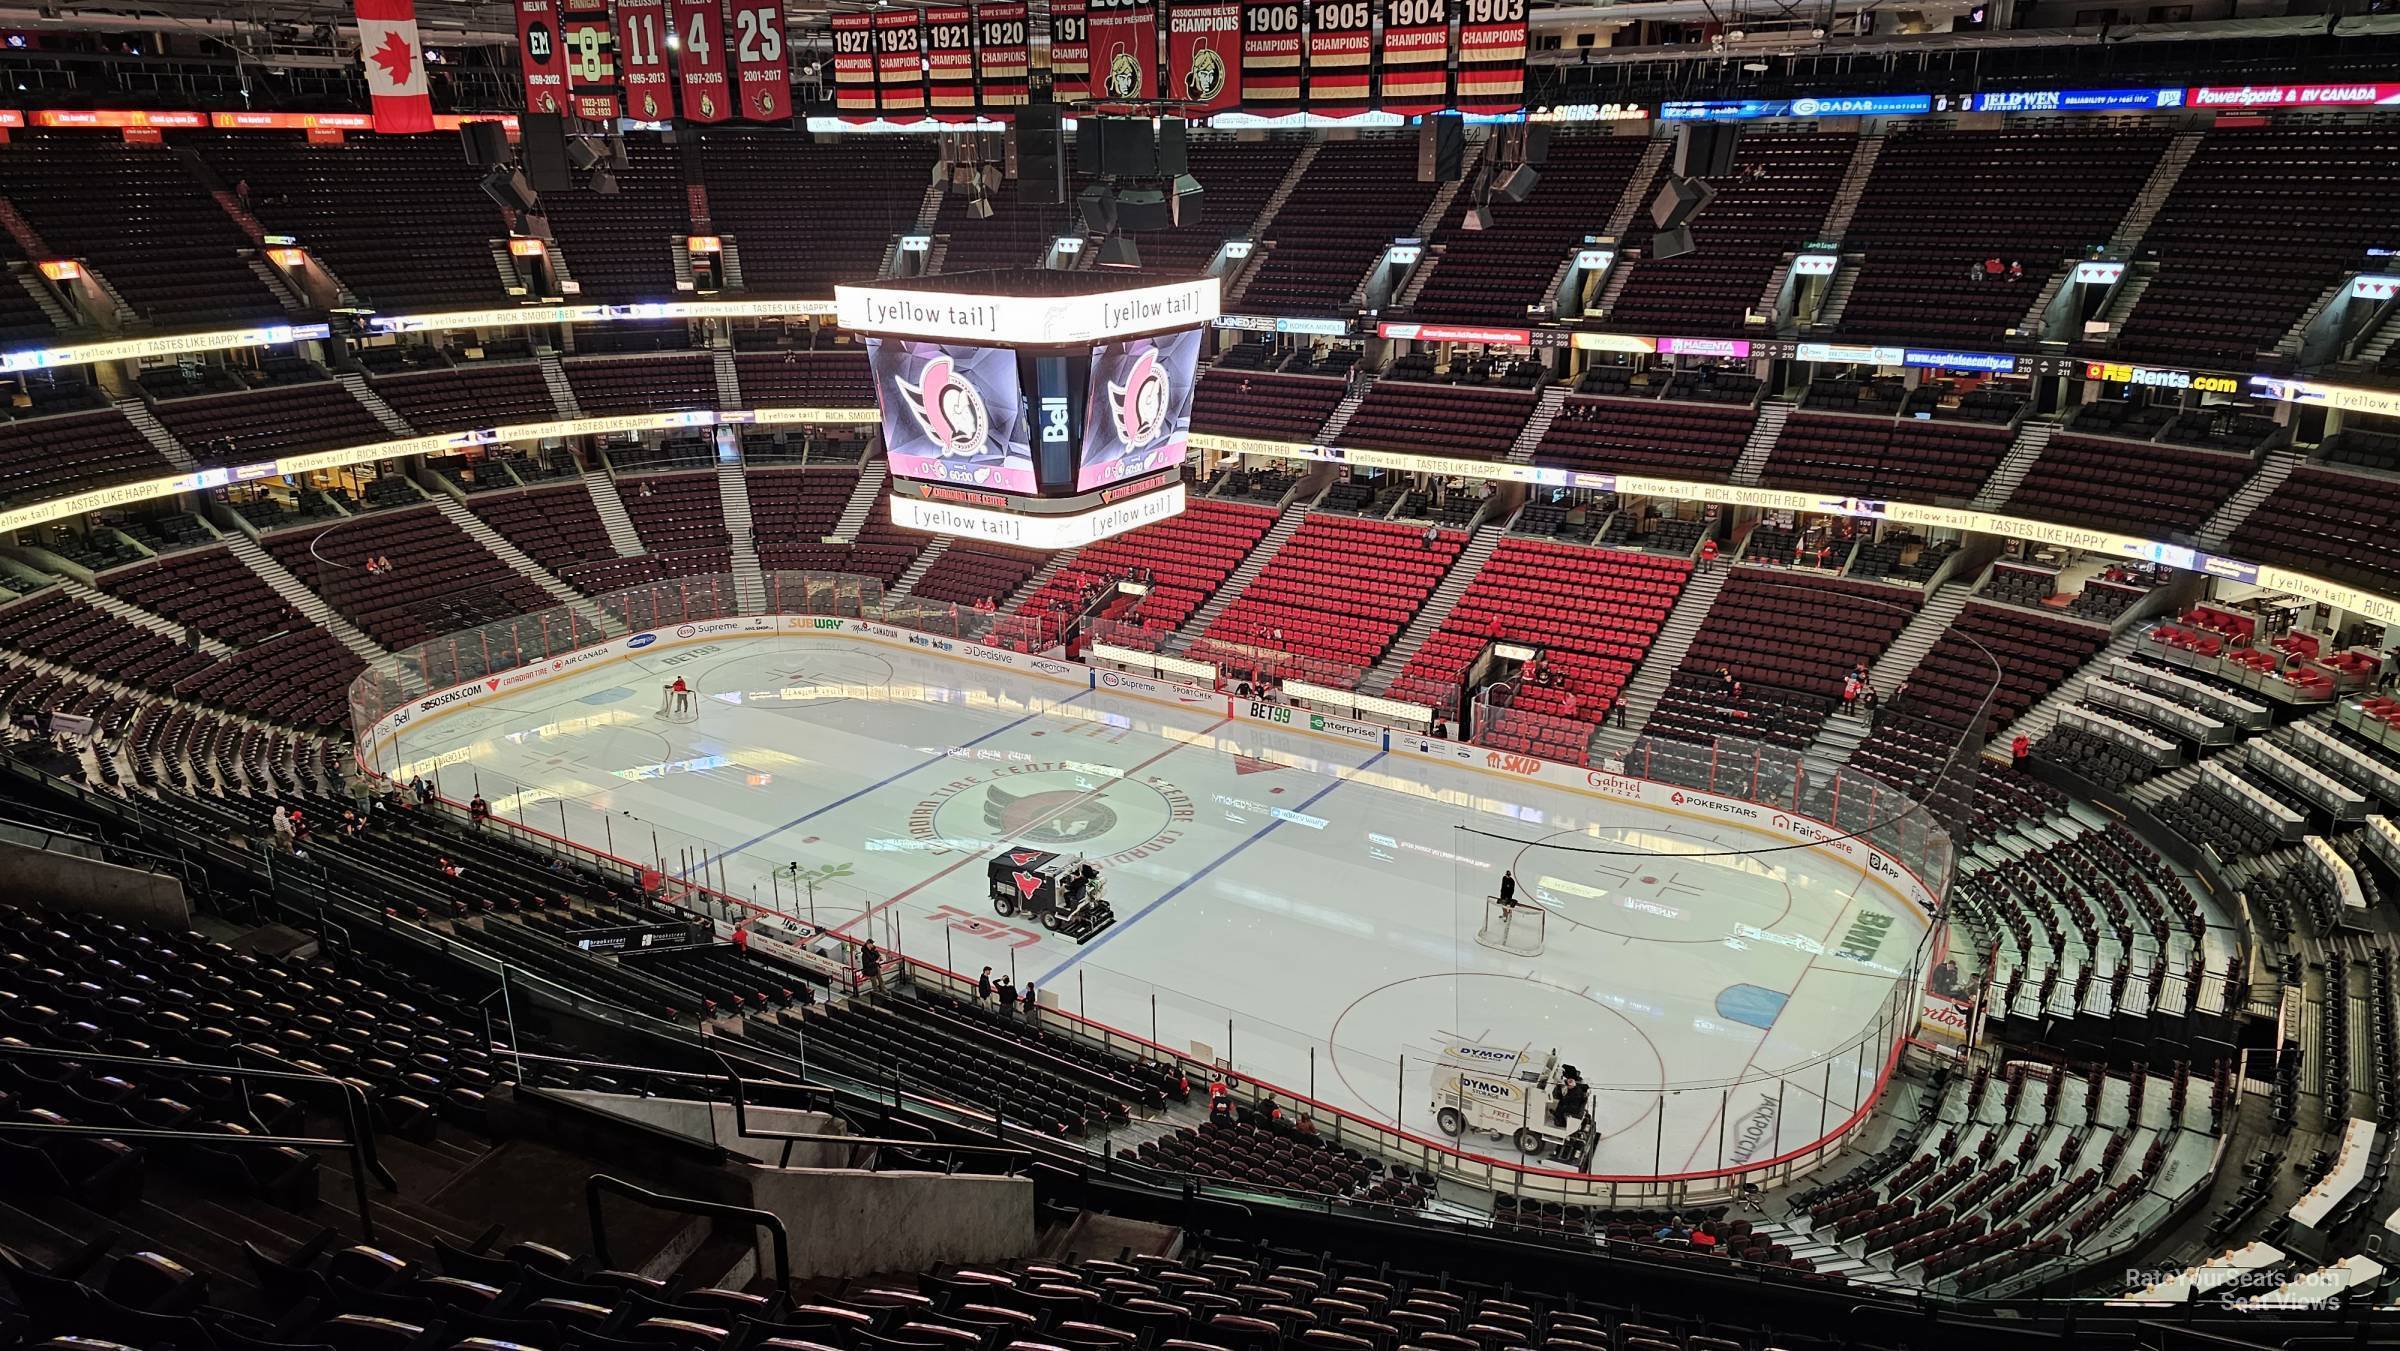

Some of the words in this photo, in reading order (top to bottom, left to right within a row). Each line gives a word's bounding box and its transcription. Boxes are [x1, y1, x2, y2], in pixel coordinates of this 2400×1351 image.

[523, 1, 548, 12] MELNYK
[569, 0, 600, 9] FINNIGAN
[1172, 8, 1213, 17] ASSOCIATION
[1214, 8, 1222, 16] DE
[1223, 6, 1239, 15] L'EST
[1466, 0, 1523, 22] 1903
[1247, 6, 1298, 32] 1906
[1315, 3, 1369, 29] 1905
[1388, 0, 1444, 25] 1904
[1171, 16, 1239, 33] CHAMPIONS
[628, 14, 659, 65] 11
[687, 13, 709, 65] 4
[736, 8, 781, 63] 25
[879, 28, 918, 51] 1923
[931, 25, 969, 47] 1921
[982, 22, 1023, 45] 1920
[1385, 31, 1446, 46] CHAMPIONS
[1462, 29, 1524, 45] CHAMPIONS
[834, 31, 869, 52] 1927
[1245, 38, 1298, 52] CHAMPIONS
[1312, 36, 1369, 50] CHAMPIONS
[580, 27, 601, 81] 8
[930, 54, 971, 65] CHAMPIONS
[981, 51, 1026, 63] CHAMPIONS
[834, 57, 872, 69] CHAMPIONS
[880, 57, 920, 68] CHAMPIONS
[528, 74, 560, 85] 1959-2022
[629, 73, 665, 84] 1995-2013
[685, 73, 722, 84] 1997-2015
[743, 70, 781, 82] 2001-2017
[582, 98, 610, 107] 1923-1931
[2196, 87, 2282, 106] PowerSports
[2285, 88, 2296, 102] &
[2301, 89, 2319, 102] RV
[2319, 87, 2376, 101] CANADA
[582, 107, 612, 116] 1932-1933
[1820, 100, 1872, 111] GADAR
[1937, 98, 1947, 111] 0
[1961, 98, 1972, 111] 0
[522, 311, 557, 321] SMOOTH
[559, 310, 576, 320] RED
[752, 304, 783, 313] TASTES
[785, 303, 801, 312] LIKE
[802, 303, 829, 312] HAPPY
[147, 339, 183, 352] TASTES
[185, 337, 206, 349] LIKE
[208, 335, 239, 346] HAPPY
[1683, 339, 1734, 350] MAGENTA
[1907, 352, 2013, 371] www.capitalsecurity.ca
[2019, 358, 2033, 366] 310
[2058, 360, 2072, 368] 311
[2018, 366, 2032, 374] 210
[572, 421, 602, 432] TASTES
[604, 419, 625, 430] LIKE
[626, 418, 654, 428] HAPPY
[1043, 397, 1070, 443] Bell
[382, 442, 419, 456] SMOOTH
[421, 439, 439, 452] RED
[1241, 441, 1273, 453] SMOOTH
[1274, 444, 1290, 455] RED
[922, 463, 929, 473] 0
[1416, 459, 1448, 472] TASTES
[1450, 462, 1469, 474] LIKE
[1471, 464, 1502, 477] HAPPY
[949, 470, 973, 482] 60:00
[994, 472, 1001, 483] 0
[65, 496, 100, 513] TASTES
[102, 490, 123, 505] LIKE
[125, 484, 160, 501] HAPPY
[1736, 492, 1781, 505] SMOOTH
[1784, 496, 1806, 507] RED
[1989, 518, 2033, 536] TASTES
[2036, 525, 2063, 541] LIKE
[2065, 531, 2108, 548] HAPPY
[698, 622, 739, 634] Supreme
[788, 618, 844, 630] SUBWAY
[873, 628, 898, 638] CANADIAN
[565, 655, 577, 666] AIR
[577, 647, 609, 664] CANADA
[973, 646, 1012, 664] Decisive
[1030, 660, 1071, 675] JACKPOTCITY
[503, 671, 534, 686] CANADIAN
[535, 667, 548, 678] TIRE
[1121, 678, 1156, 692] Supreme
[394, 709, 410, 727] Bell
[1250, 702, 1291, 724] BET99
[1313, 718, 1376, 738] enterprise
[1501, 755, 1541, 775] SKIP
[1587, 771, 1641, 794] Gabriel
[1603, 786, 1641, 799] PIZZA
[1686, 796, 1758, 818] POKERSTARS
[1792, 821, 1853, 854] FairSquare
[1461, 1048, 1515, 1060] DYMON
[1461, 1079, 1509, 1097] DYMON
[1472, 1089, 1499, 1099] STORAGE
[1493, 1109, 1511, 1119] FREE
[1729, 1093, 1775, 1164] JACKPOTCITY
